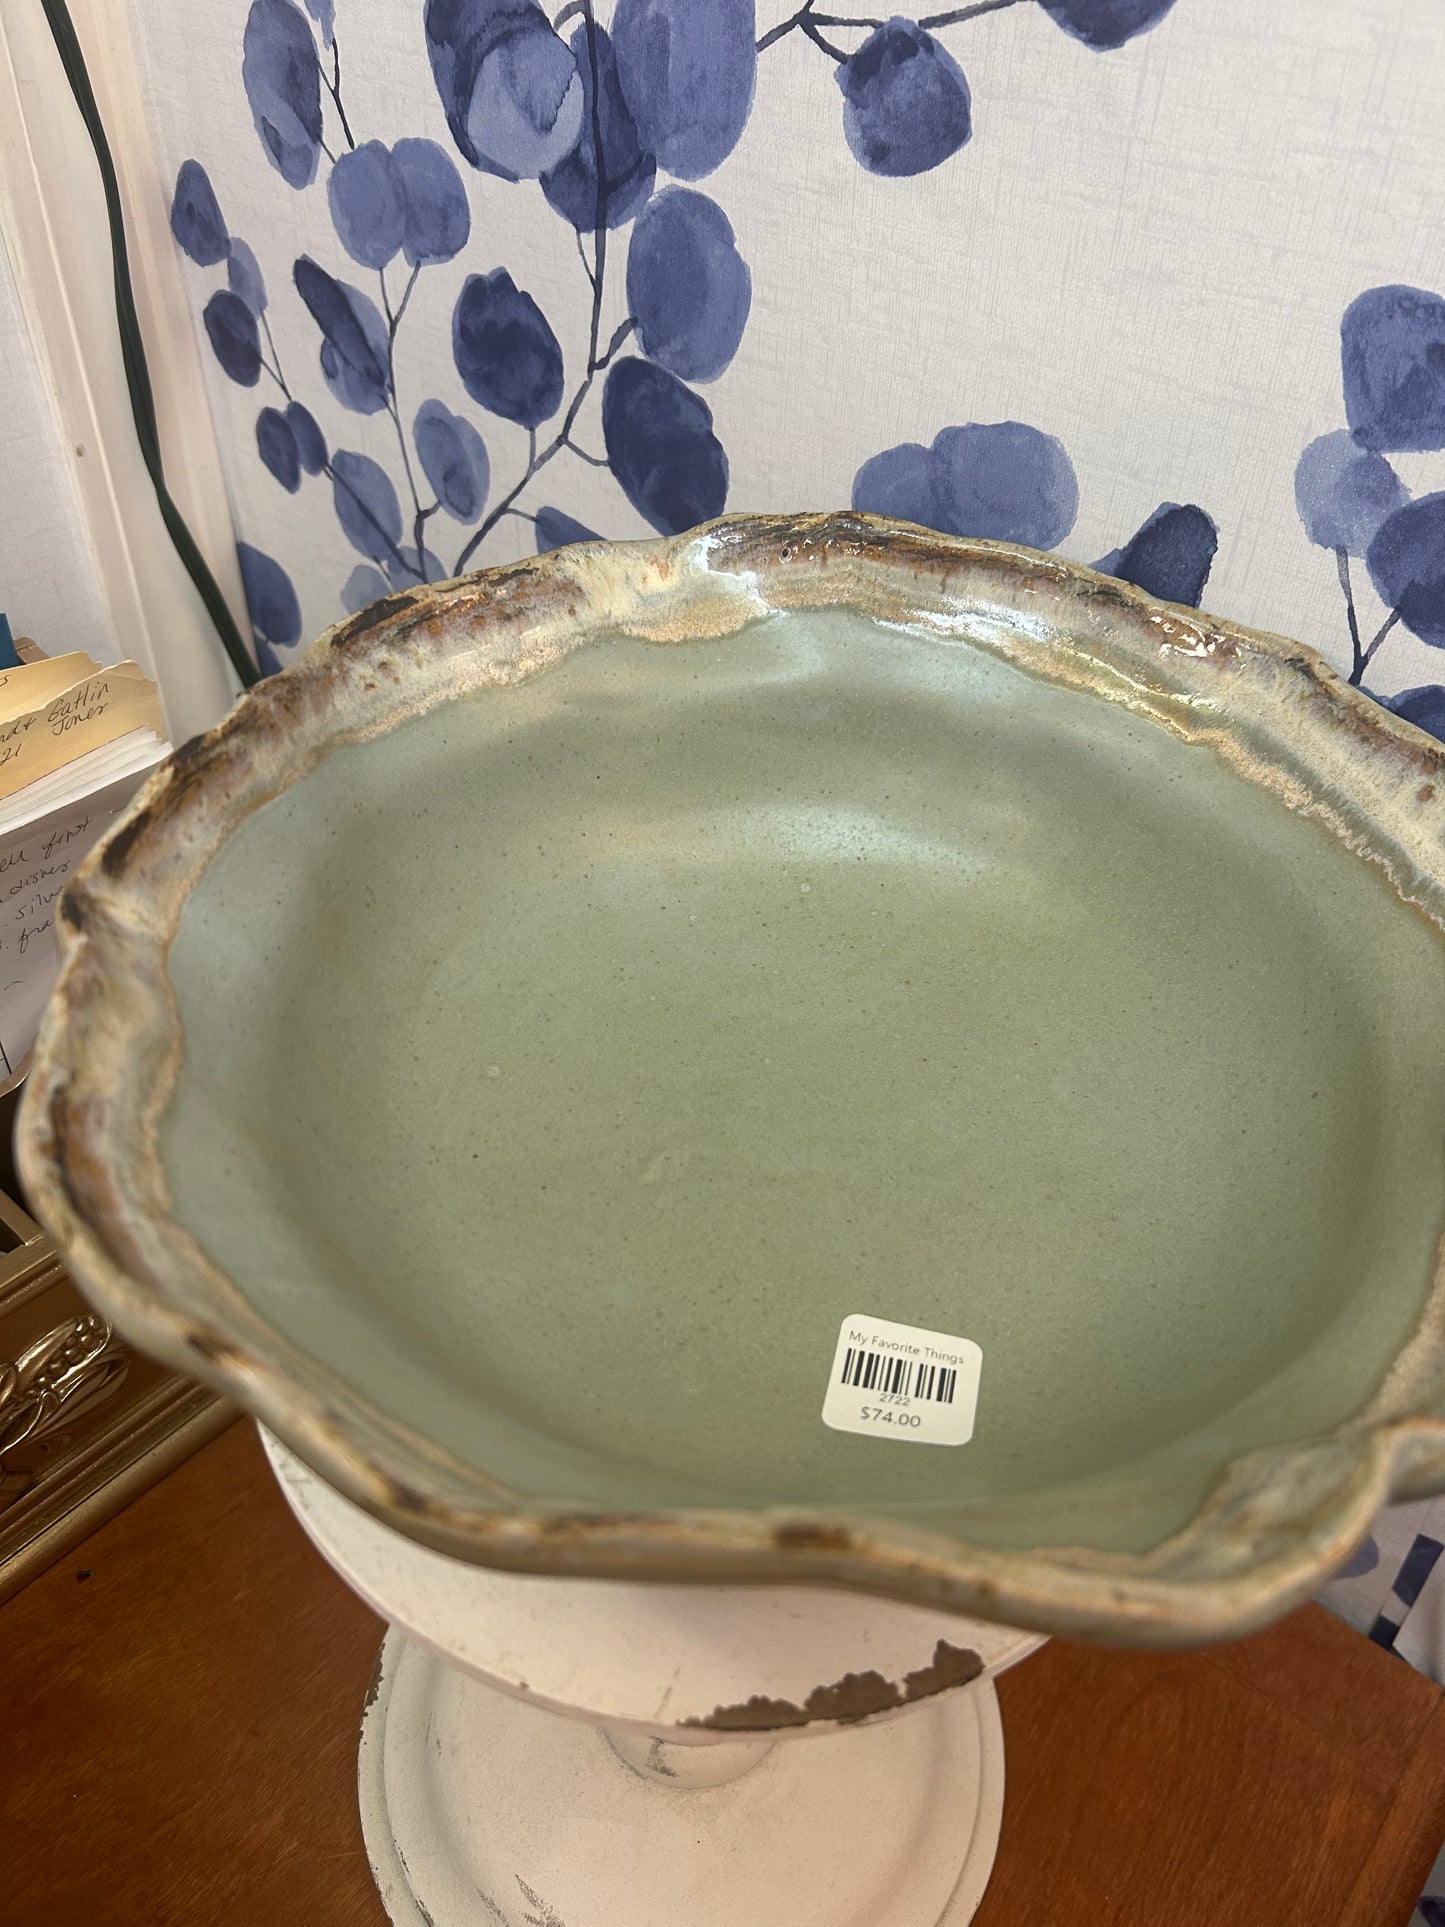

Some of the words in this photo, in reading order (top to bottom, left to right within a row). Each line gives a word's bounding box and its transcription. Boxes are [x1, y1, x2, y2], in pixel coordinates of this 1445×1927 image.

[51, 702, 108, 736] Jones
[848, 1330, 868, 1345] My
[871, 1336, 920, 1355] Favorite
[924, 1347, 964, 1365] Things
[879, 1392, 911, 1407] 2722
[860, 1406, 921, 1427] $74.00
